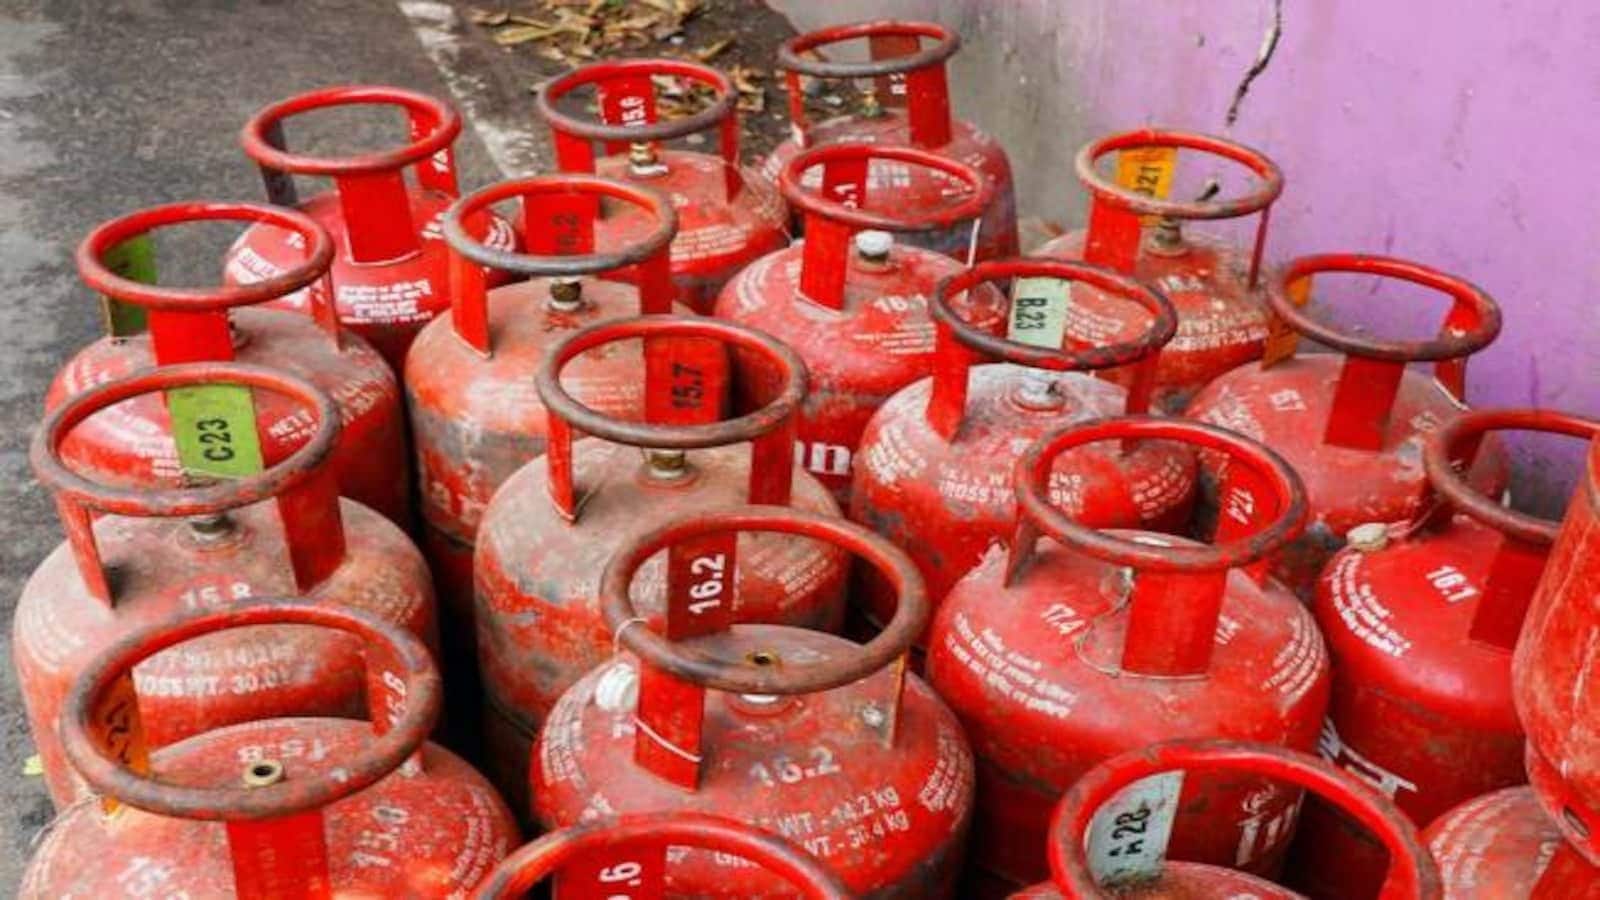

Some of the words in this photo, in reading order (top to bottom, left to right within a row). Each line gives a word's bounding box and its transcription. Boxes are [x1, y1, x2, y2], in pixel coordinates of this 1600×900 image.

[195, 418, 235, 462] C23
[687, 553, 726, 615] 16.2
[749, 745, 842, 788] 16.2
[598, 861, 643, 900] .6
